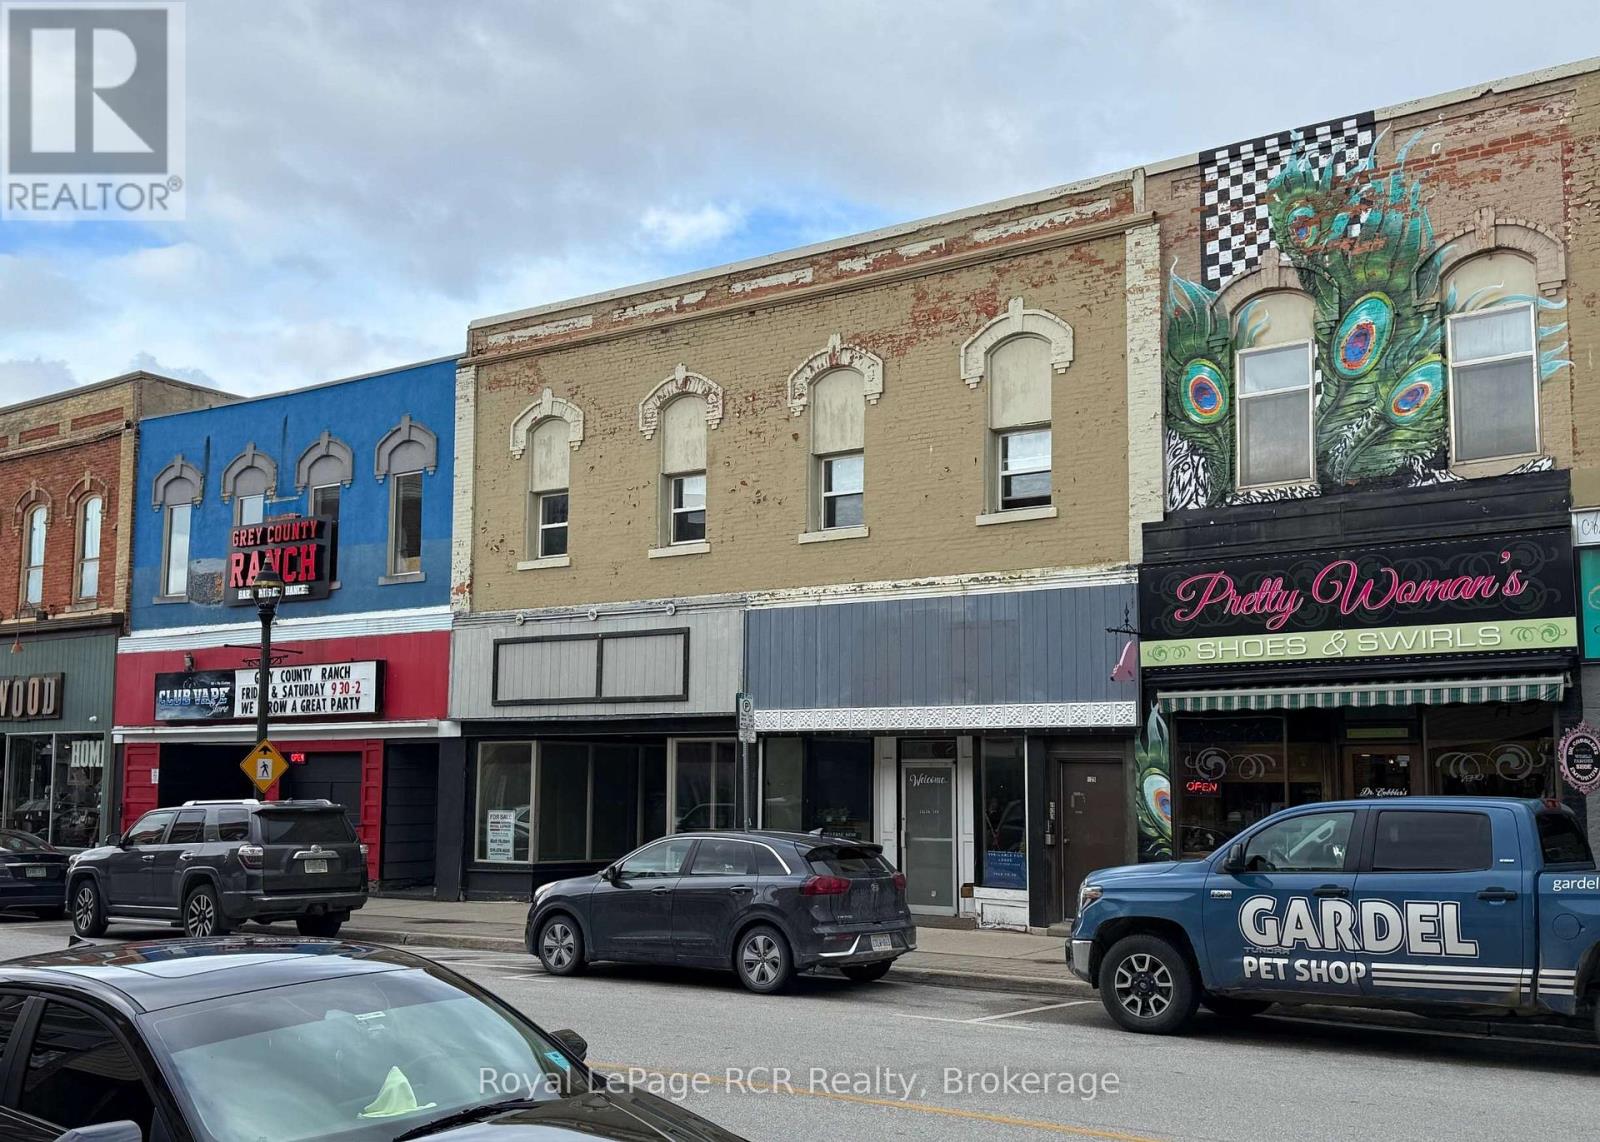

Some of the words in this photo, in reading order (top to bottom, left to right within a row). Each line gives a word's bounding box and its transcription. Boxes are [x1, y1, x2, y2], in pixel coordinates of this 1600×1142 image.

[232, 526, 262, 547] GREY
[267, 519, 317, 543] COUNTY
[229, 543, 317, 588] RANCH
[1173, 571, 1304, 631] Pretty
[1311, 550, 1528, 616] Woman's
[1196, 635, 1308, 661] SHOES
[1320, 631, 1348, 657] &
[1356, 624, 1503, 653] SWIRLS
[254, 670, 274, 684] GY
[280, 668, 313, 683] COUNTY
[321, 665, 351, 679] RANCH
[159, 688, 191, 706] CLUB
[192, 687, 231, 706] VAPE
[241, 686, 258, 700] FRID
[271, 686, 278, 698] &
[282, 683, 326, 698] SATURDAY
[241, 702, 254, 714] WE
[267, 700, 288, 714] ROW
[291, 699, 297, 712] A
[300, 698, 327, 713] GREAT
[331, 697, 361, 711] PARTY
[1186, 781, 1218, 792] OPEN
[1552, 876, 1600, 892] gardel
[1238, 895, 1480, 958] GARDEL
[1243, 955, 1290, 981] PET
[1295, 958, 1366, 985] SHOP
